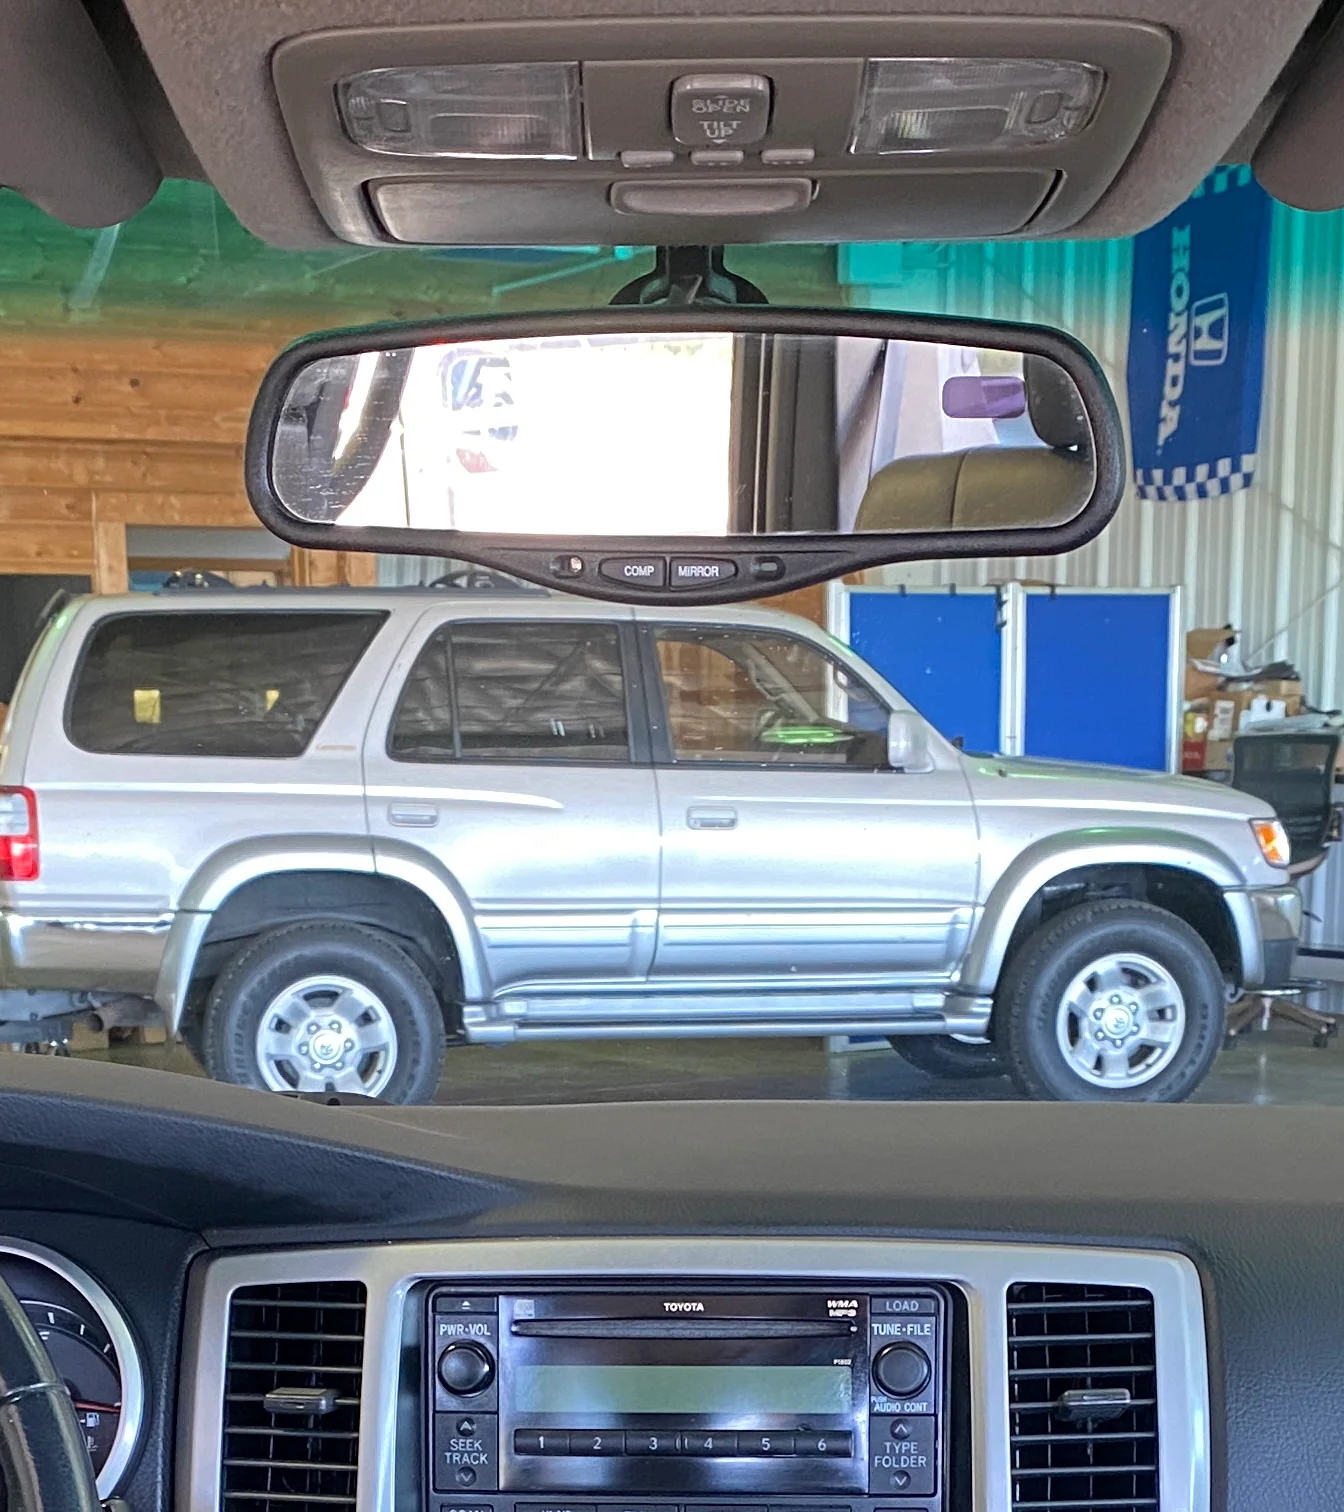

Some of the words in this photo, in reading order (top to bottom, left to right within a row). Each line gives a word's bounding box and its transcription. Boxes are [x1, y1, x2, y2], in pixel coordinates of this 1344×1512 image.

[1157, 224, 1191, 447] HONDA
[624, 566, 655, 577] COMP
[678, 566, 720, 577] MIRROR
[663, 1302, 704, 1312] TOYOTA
[827, 1300, 858, 1308] WMA
[885, 1300, 919, 1312] LOAD
[874, 1402, 902, 1413] AUDIO
[904, 1402, 928, 1413] CONT
[450, 1439, 483, 1451] SEEK
[538, 1435, 545, 1449] 1
[592, 1436, 602, 1450] 2
[648, 1437, 658, 1450] 3
[703, 1437, 713, 1450] 4
[761, 1438, 771, 1451] 5
[817, 1438, 827, 1451] 6
[884, 1442, 918, 1454] TYPE
[445, 1452, 488, 1465] TRACK
[874, 1455, 927, 1468] FOLDER
